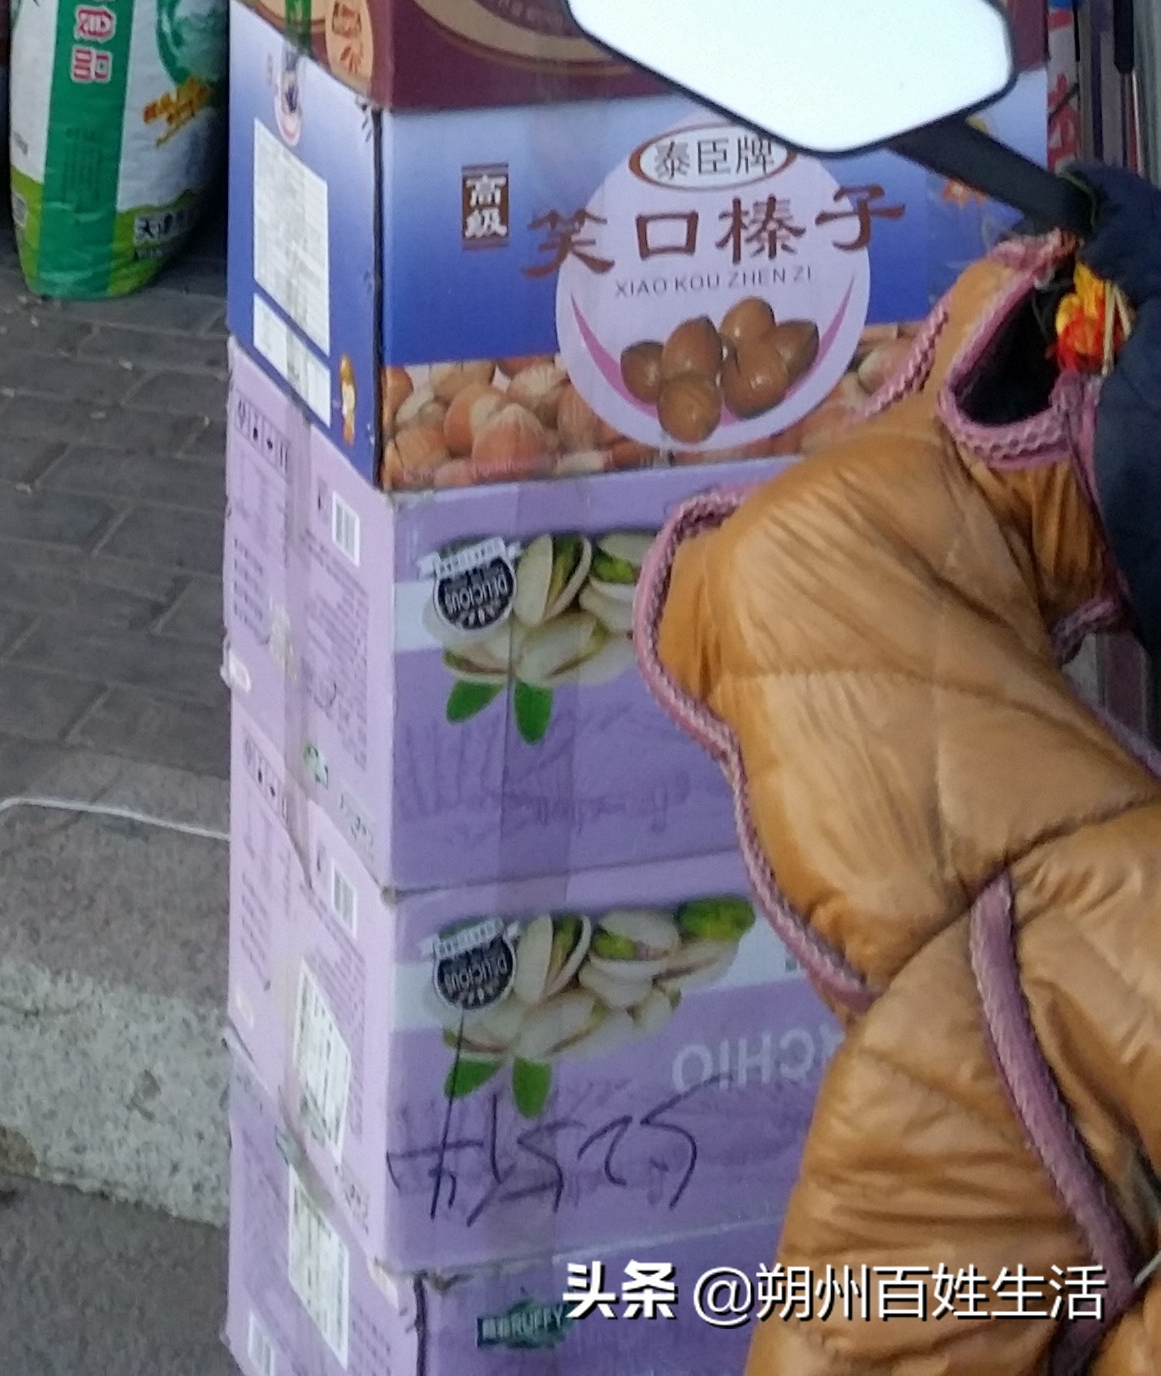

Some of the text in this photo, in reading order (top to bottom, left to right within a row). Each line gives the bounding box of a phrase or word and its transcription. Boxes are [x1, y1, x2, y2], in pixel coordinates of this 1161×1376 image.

[654, 136, 776, 181] 泰臣牌
[522, 184, 906, 278] 笑口榛子
[615, 265, 813, 299] XIAO KOU ZHEN ZI
